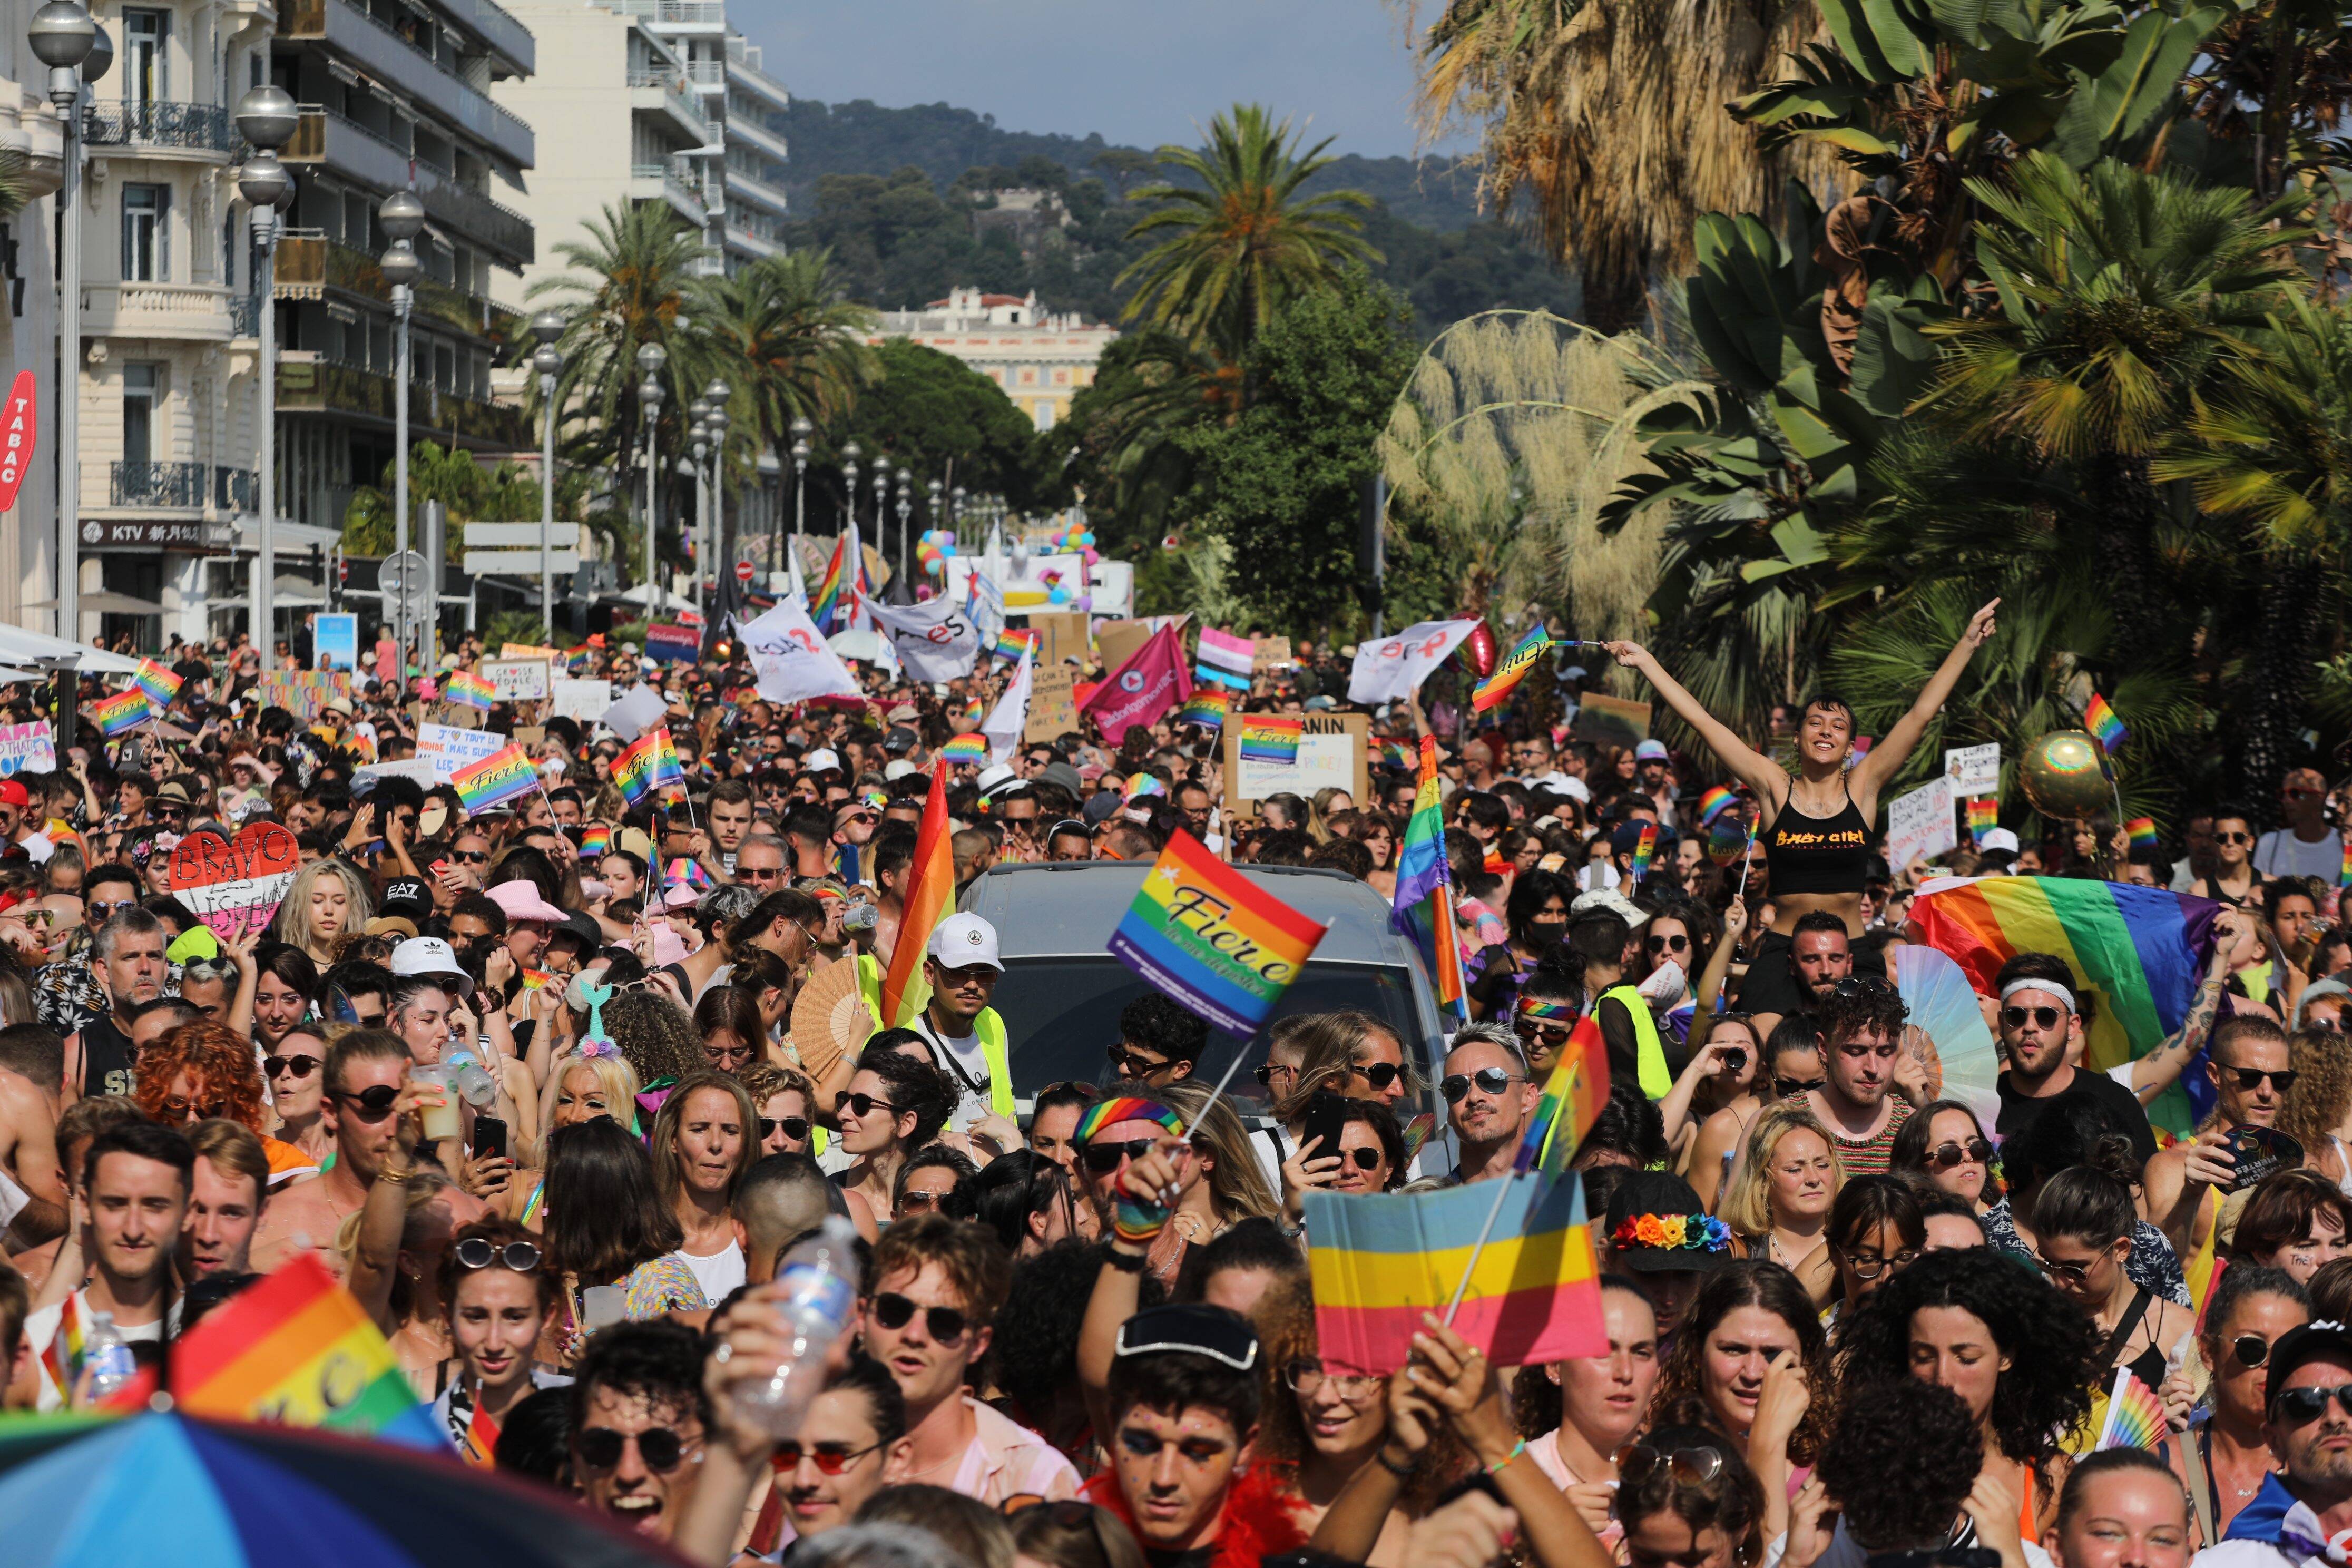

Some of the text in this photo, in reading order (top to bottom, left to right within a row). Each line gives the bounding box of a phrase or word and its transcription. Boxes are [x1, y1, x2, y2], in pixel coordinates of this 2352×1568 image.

[1, 398, 28, 483] TABAC
[112, 525, 143, 541] KTV
[465, 733, 485, 743] TOUT
[6, 739, 30, 754] THAT
[417, 741, 445, 752] MONDE
[436, 758, 454, 771] LES
[1776, 829, 1865, 846] BABY GIRL
[178, 830, 289, 880] BRAVO
[211, 875, 253, 894] LES
[387, 883, 419, 897] EA7
